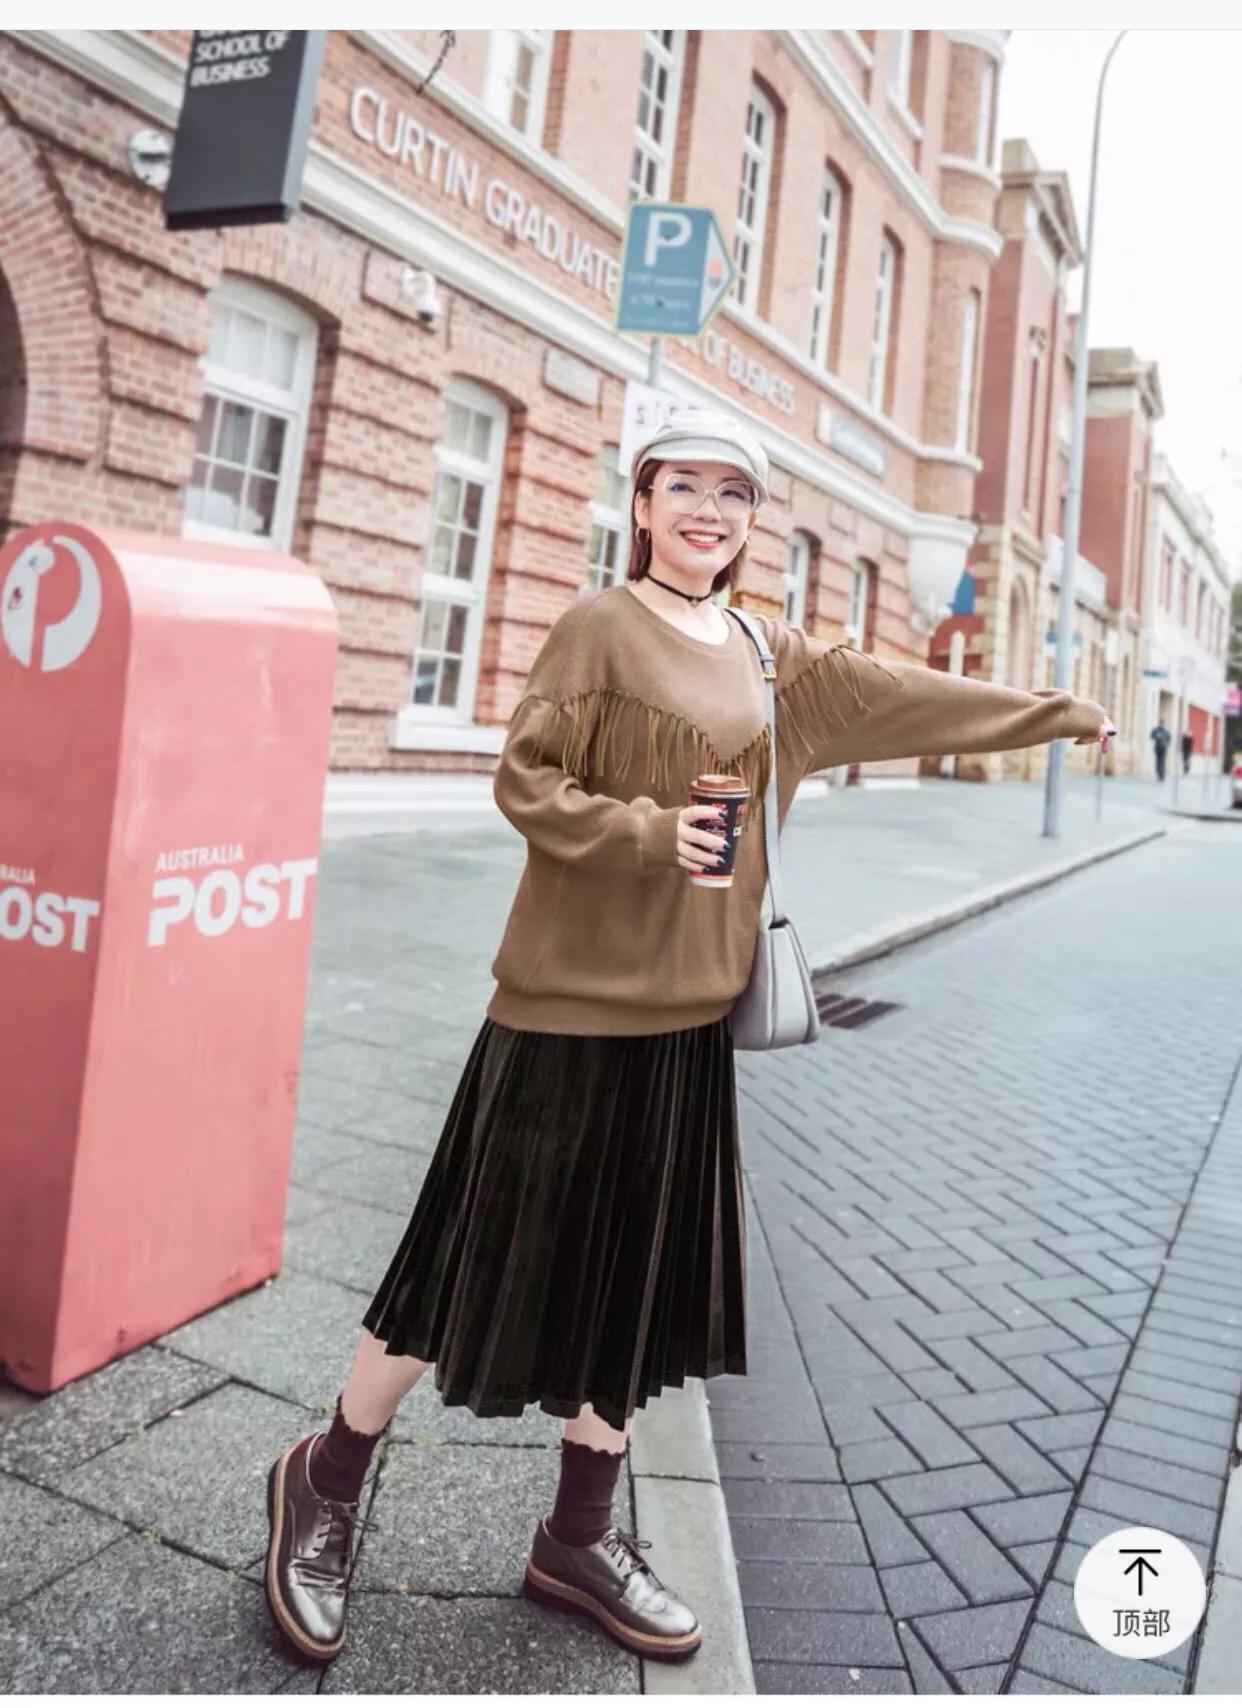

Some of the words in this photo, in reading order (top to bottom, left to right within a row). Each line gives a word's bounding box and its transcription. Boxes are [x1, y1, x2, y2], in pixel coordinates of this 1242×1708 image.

[195, 34, 262, 63] SCHOOL
[265, 30, 291, 51] OF
[190, 56, 271, 87] BUSINESS
[350, 85, 481, 209] CURTIN
[484, 179, 621, 299] GRADUATE
[704, 329, 728, 366] OF
[728, 344, 797, 416] BUSINESS
[644, 211, 693, 267] P
[154, 843, 245, 873] AUSTRALIA
[147, 857, 319, 947] POST
